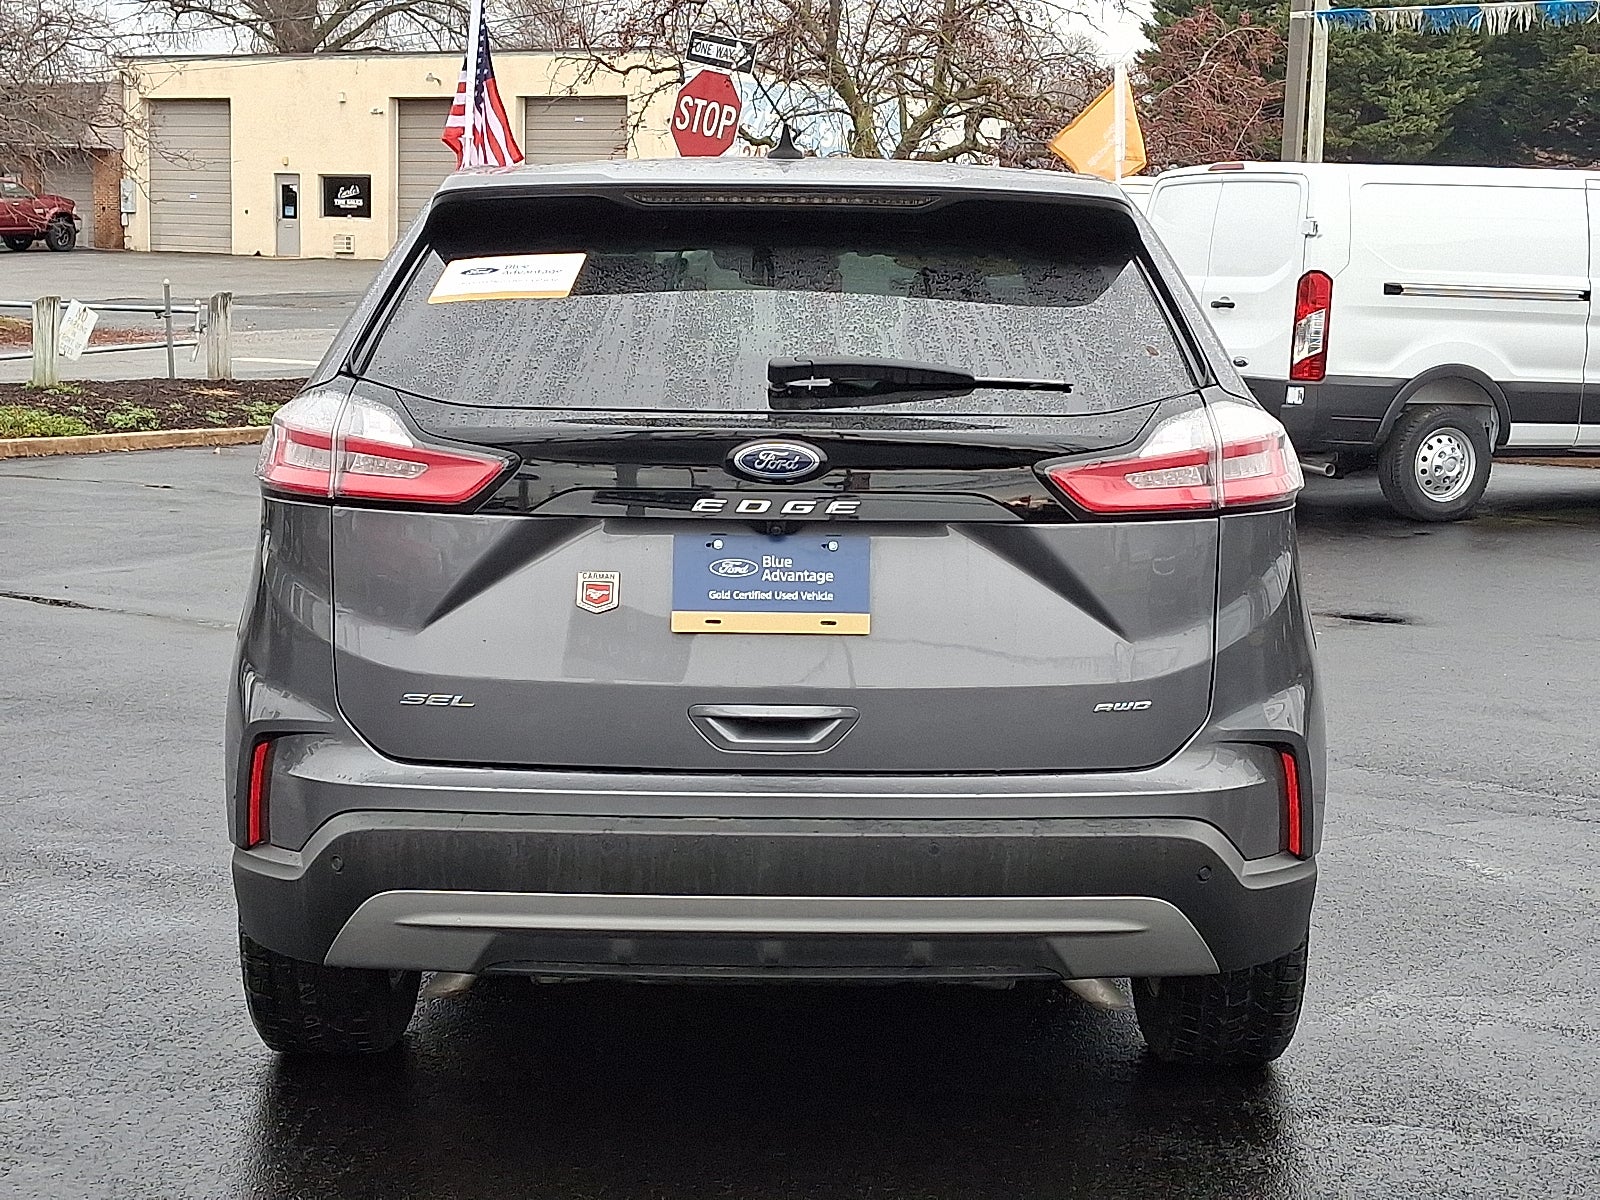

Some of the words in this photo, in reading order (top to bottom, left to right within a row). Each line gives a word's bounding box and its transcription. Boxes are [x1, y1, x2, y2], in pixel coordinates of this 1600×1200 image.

[694, 40, 713, 57] ONE
[715, 44, 734, 60] WAY
[675, 95, 737, 140] STOP
[754, 449, 800, 471] Ford
[691, 498, 861, 515] EDGE
[718, 560, 750, 574] Ford
[762, 555, 793, 568] Blue
[582, 572, 616, 580] CARMAN
[762, 569, 834, 585] Advantage
[708, 590, 731, 601] Gold
[733, 590, 773, 601] Certified
[774, 591, 799, 601] Used
[800, 591, 834, 602] Vehicle
[399, 693, 476, 707] SEL
[1092, 700, 1152, 713] AWD
